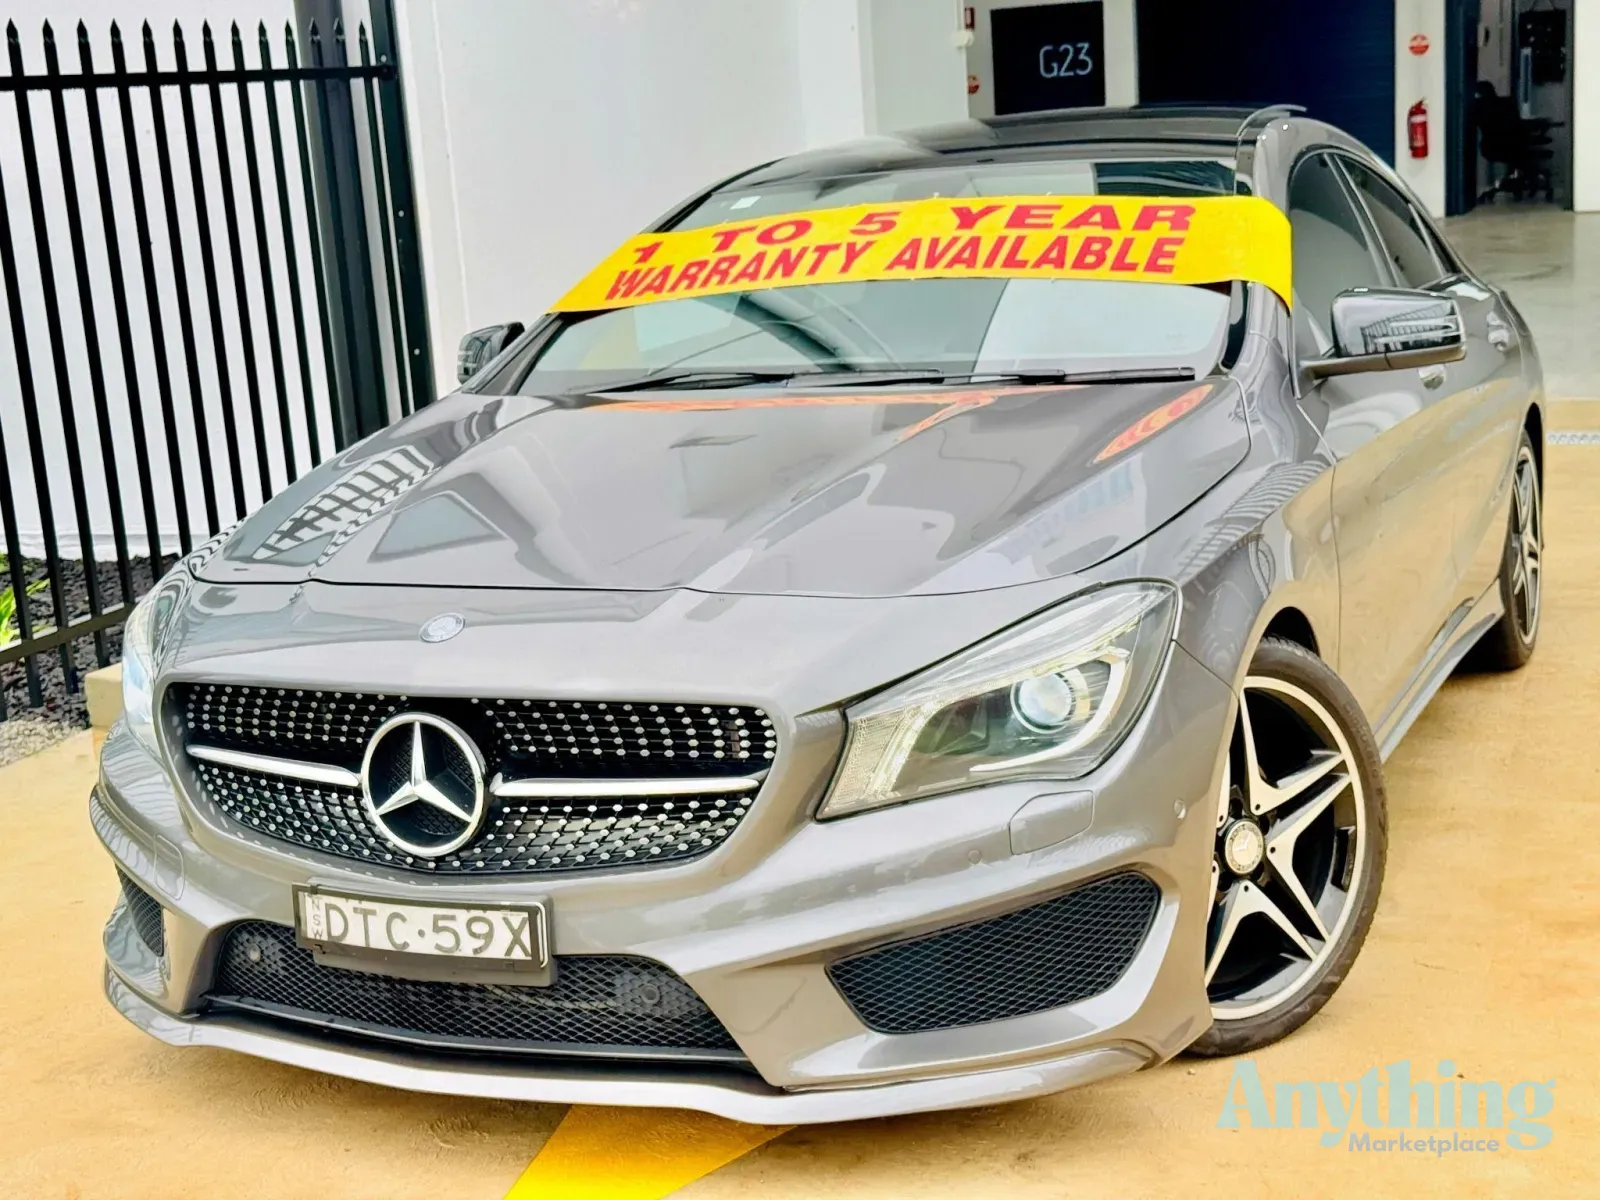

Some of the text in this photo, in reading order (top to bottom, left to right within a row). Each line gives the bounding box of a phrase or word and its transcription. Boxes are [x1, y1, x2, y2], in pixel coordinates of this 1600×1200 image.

[1039, 42, 1093, 78] G23
[632, 204, 1196, 263] 1 TO 5 YEAR
[606, 235, 1186, 300] WARRANTY AVAILABLE
